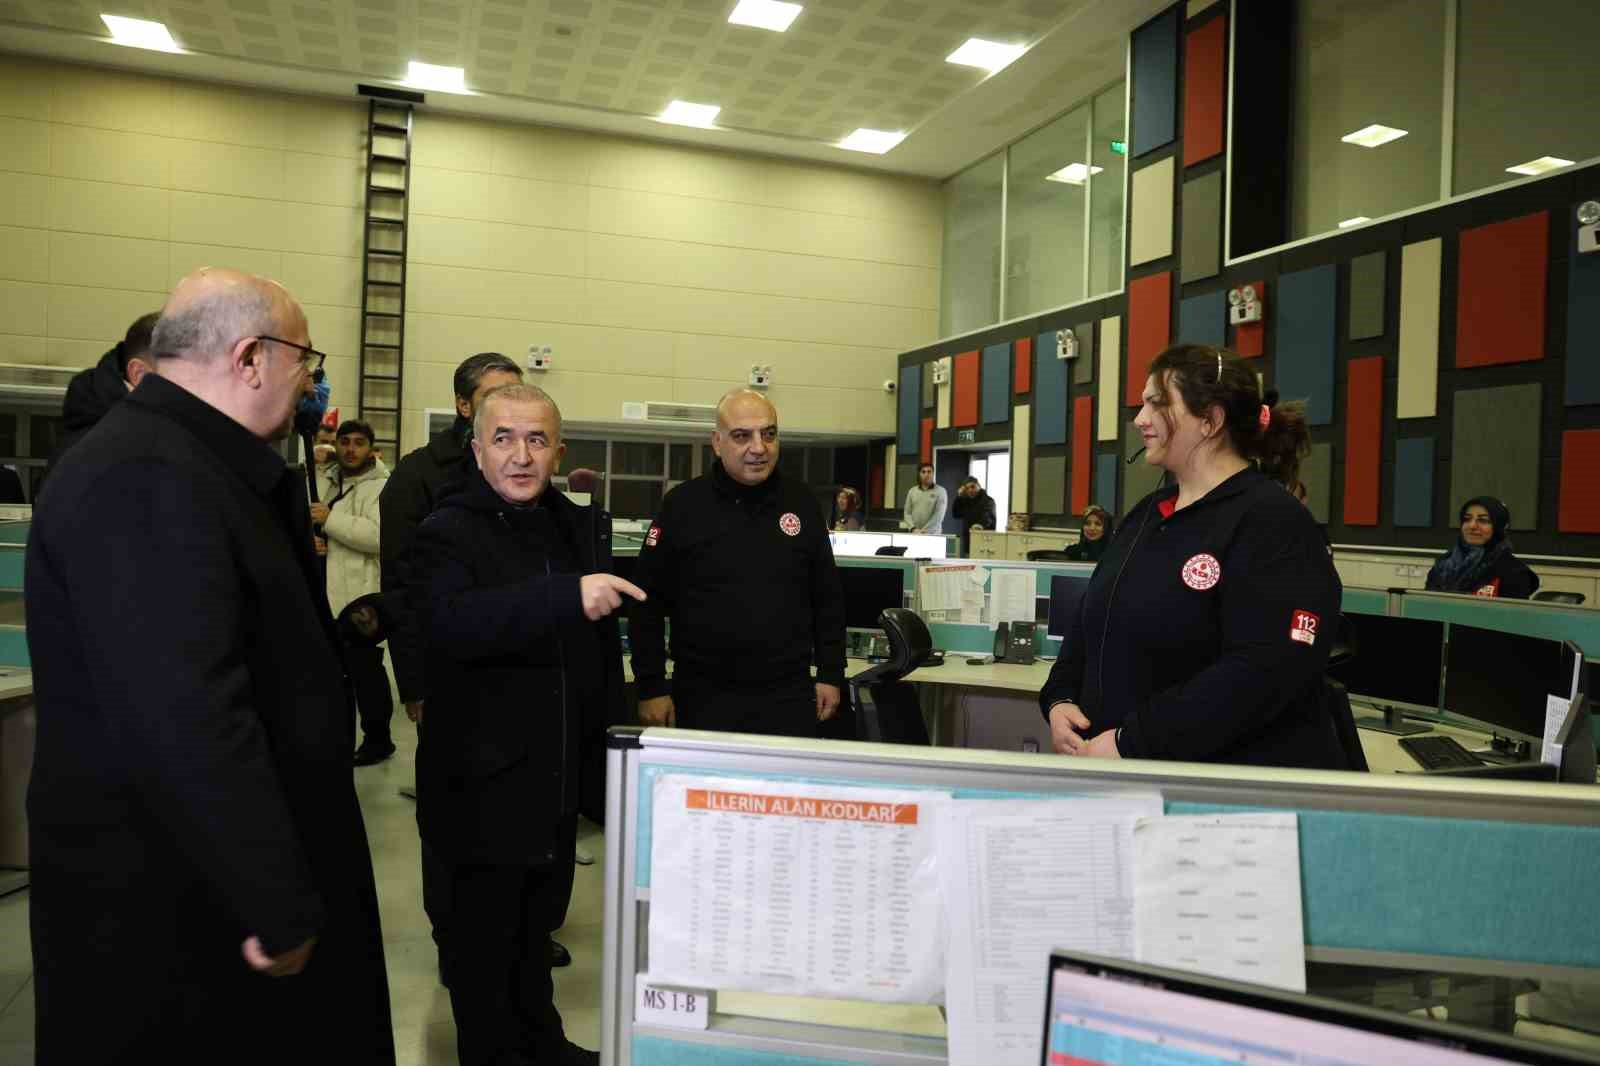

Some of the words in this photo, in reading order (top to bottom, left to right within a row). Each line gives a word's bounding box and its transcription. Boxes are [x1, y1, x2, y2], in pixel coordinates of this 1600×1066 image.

[1297, 614, 1316, 632] 112
[770, 797, 816, 817] ALAN
[643, 990, 666, 1009] MS
